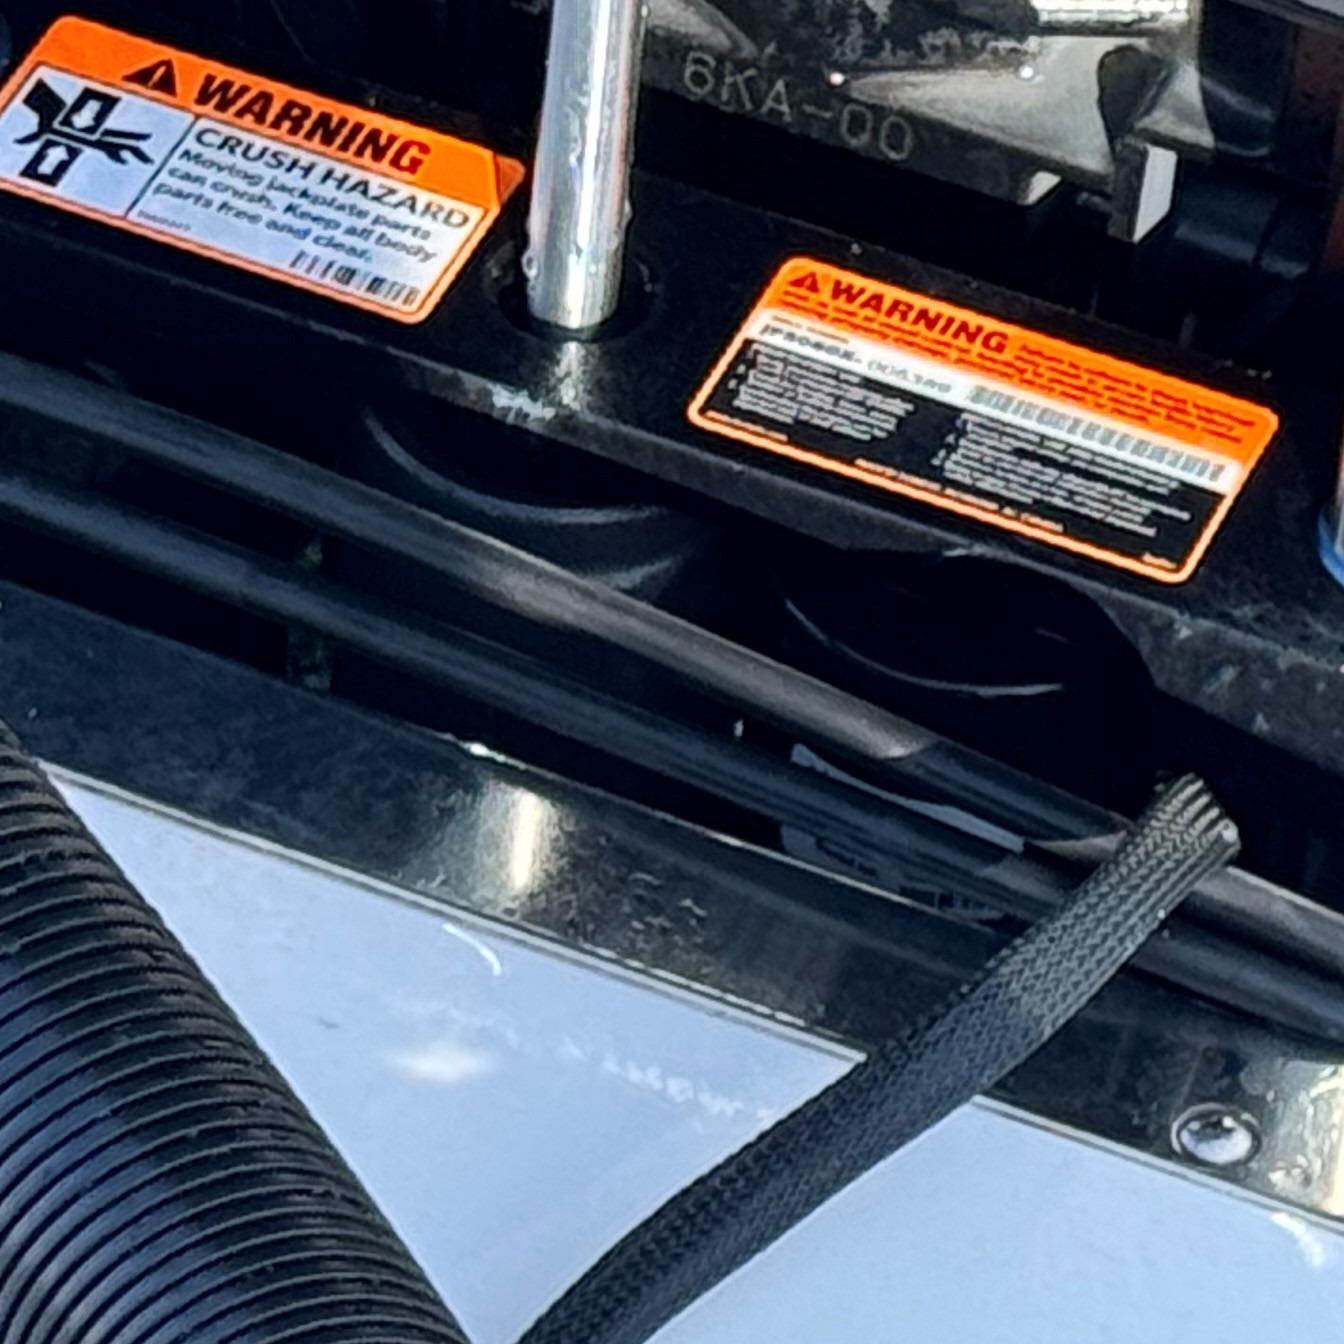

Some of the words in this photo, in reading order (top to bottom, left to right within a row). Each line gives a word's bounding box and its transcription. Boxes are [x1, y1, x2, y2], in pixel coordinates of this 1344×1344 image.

[193, 72, 432, 176] WARNING
[683, 50, 913, 161] 6KA-00
[153, 182, 214, 210] parts
[216, 199, 264, 225] free
[264, 217, 313, 243] and
[166, 166, 208, 187] can
[282, 203, 342, 237] Keep
[374, 231, 438, 264] body
[179, 148, 265, 189] Moving
[266, 174, 370, 221] jackplate
[370, 213, 432, 241] parts
[195, 127, 316, 181] CRUSH
[318, 165, 471, 229] HAZARD
[830, 278, 1009, 355] WARNING
